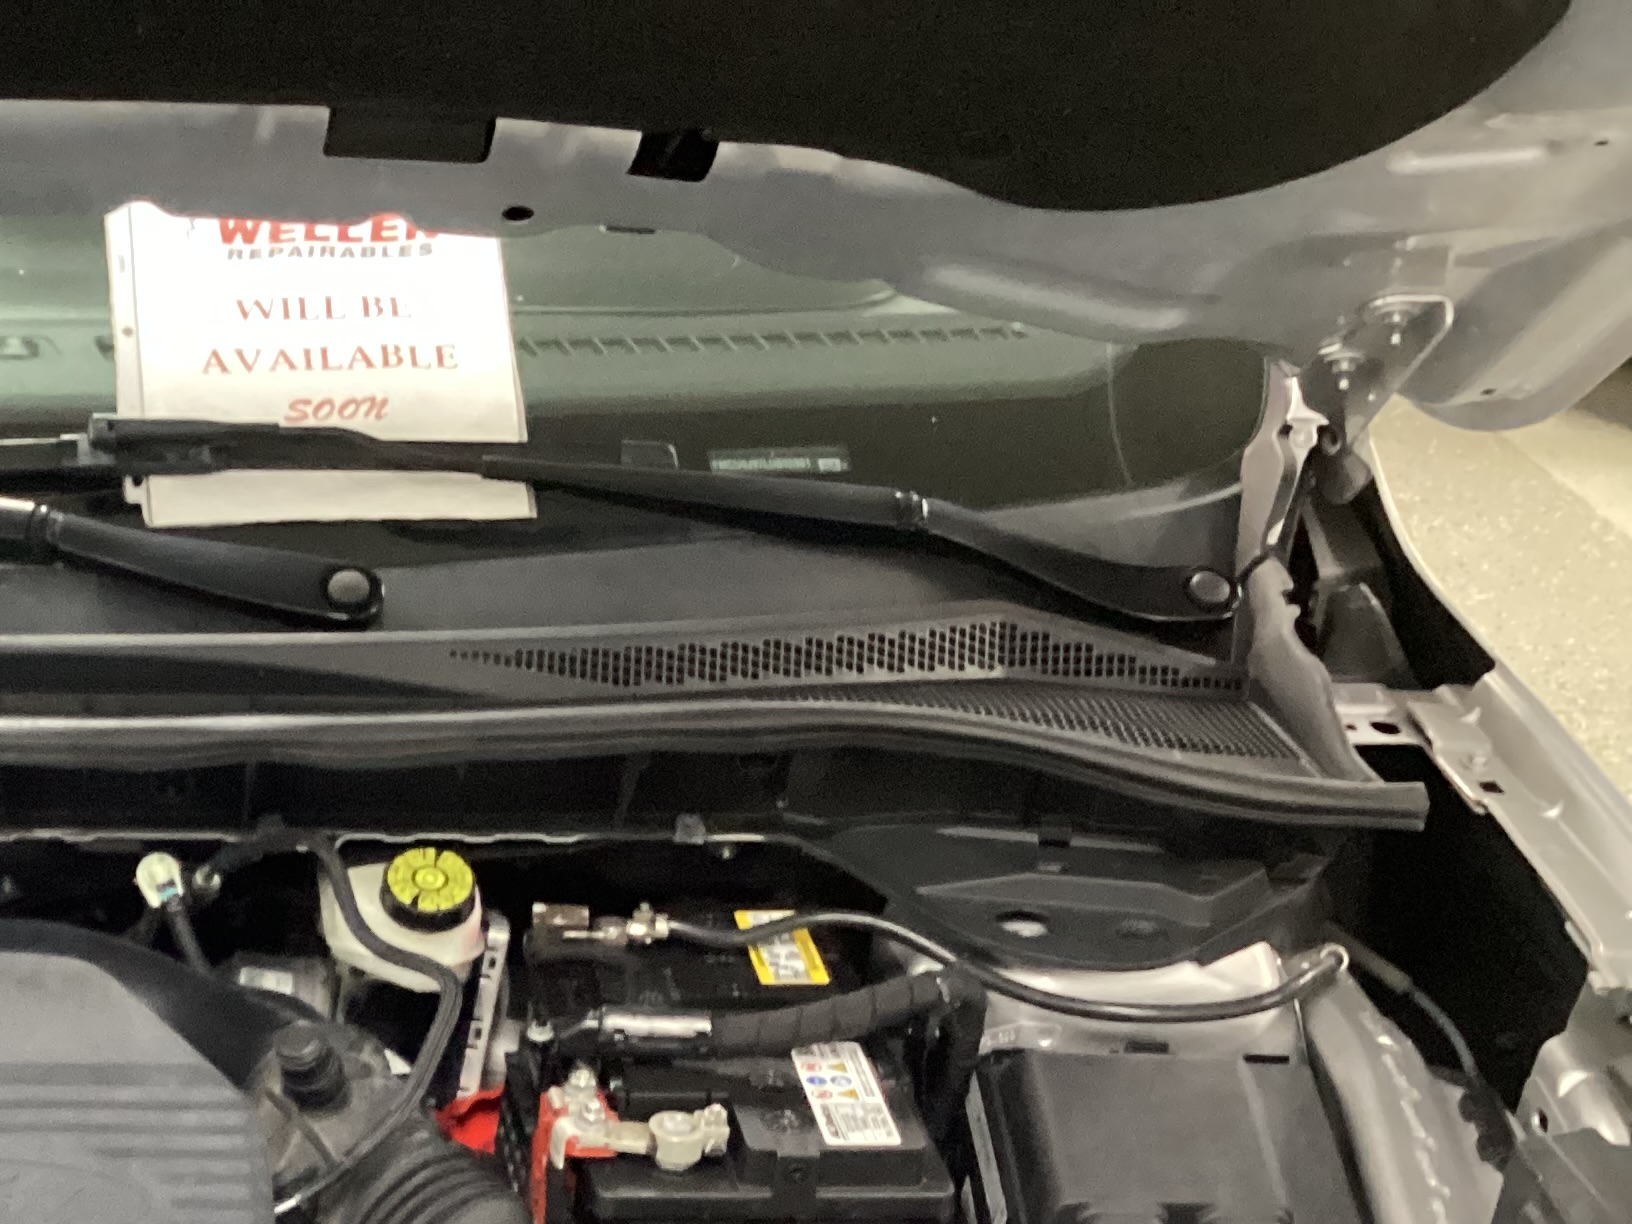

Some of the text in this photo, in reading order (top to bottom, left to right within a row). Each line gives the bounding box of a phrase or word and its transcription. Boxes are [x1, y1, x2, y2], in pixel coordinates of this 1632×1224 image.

[228, 244, 434, 260] REPAIRABLES
[236, 295, 411, 320] WILL BE
[202, 343, 458, 374] AVAILABLE
